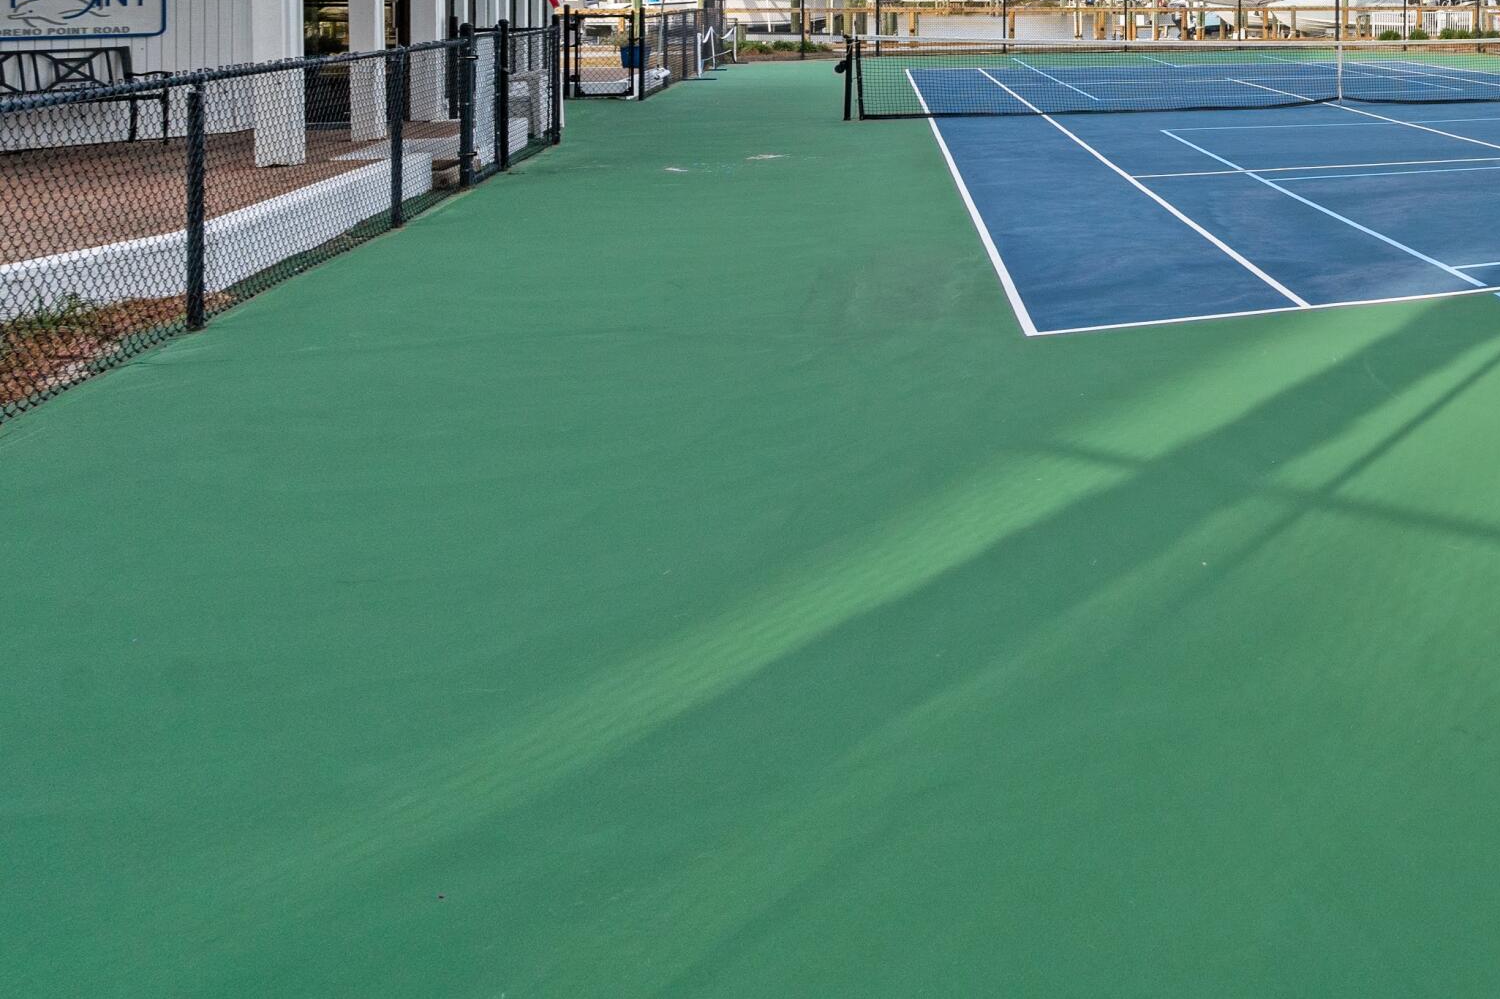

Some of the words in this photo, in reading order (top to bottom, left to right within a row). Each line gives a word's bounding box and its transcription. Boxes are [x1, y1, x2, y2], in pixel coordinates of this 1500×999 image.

[0, 29, 42, 37] RENO
[47, 27, 88, 35] POINT
[93, 26, 130, 34] ROAD
